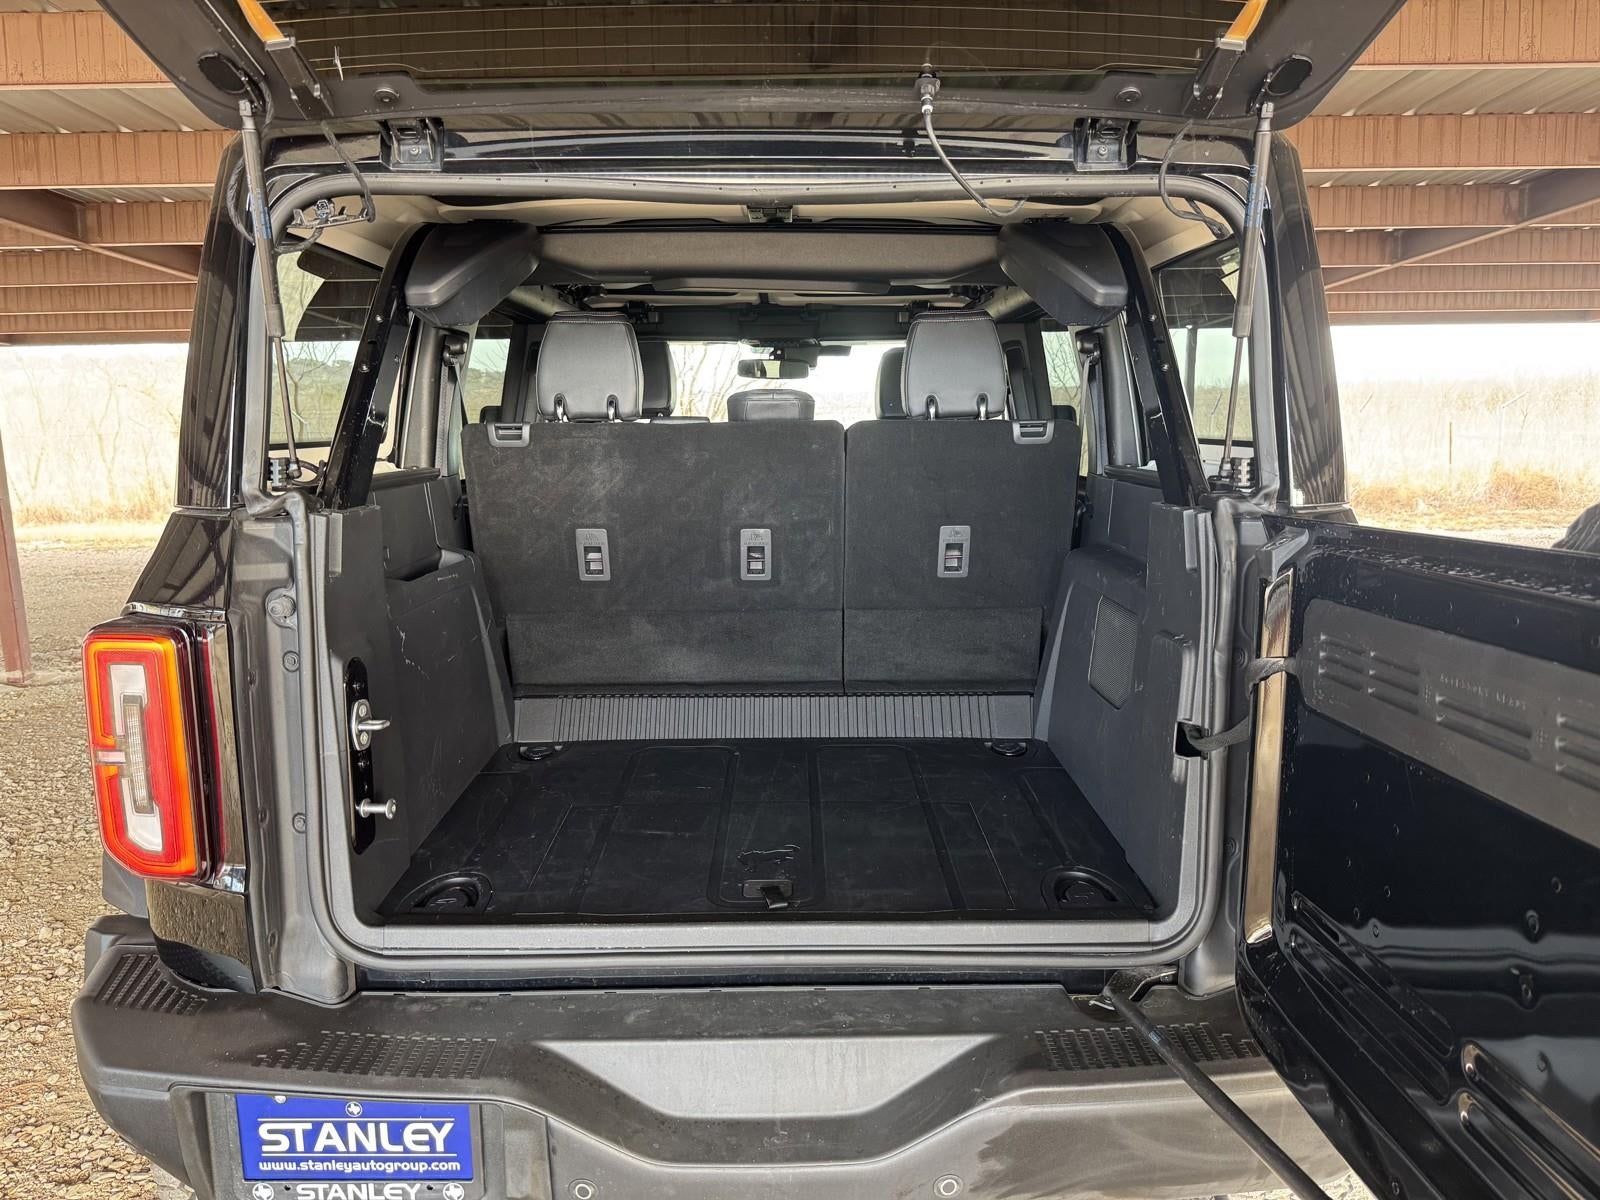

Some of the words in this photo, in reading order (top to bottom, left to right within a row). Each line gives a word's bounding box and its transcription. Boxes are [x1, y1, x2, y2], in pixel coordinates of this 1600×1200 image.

[258, 1122, 455, 1153] STANLEY
[258, 1159, 461, 1174] www.stanleyautogroup.com
[296, 1183, 422, 1200] STANLEY
